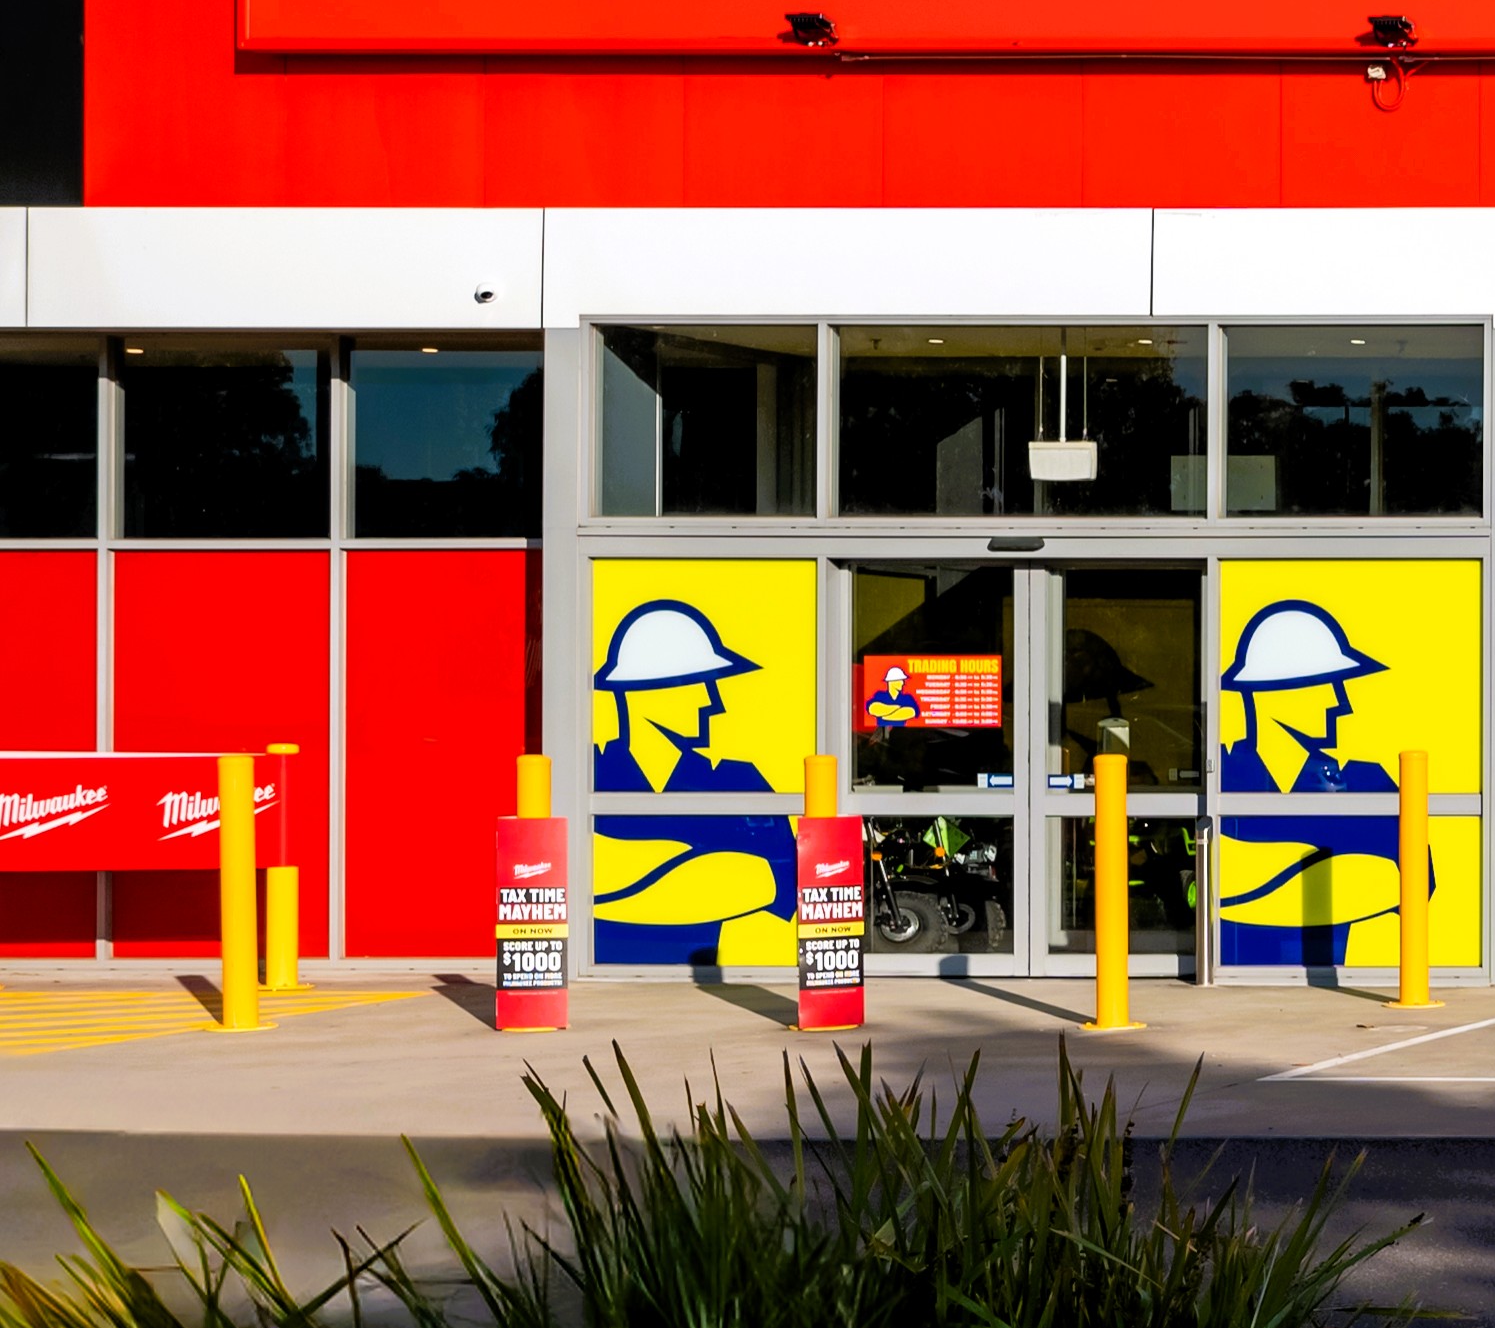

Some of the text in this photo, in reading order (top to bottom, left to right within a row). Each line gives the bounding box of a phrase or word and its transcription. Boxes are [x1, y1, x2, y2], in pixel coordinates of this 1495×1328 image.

[907, 659, 999, 674] TRADING HOURS
[156, 784, 276, 828] Milwee
[500, 888, 565, 903] TAX TIME
[802, 886, 861, 903] TAX TIME
[499, 904, 567, 920] MAYHEM
[801, 902, 863, 920] MAYHEM
[503, 941, 563, 951] SCORE UP TO
[806, 939, 860, 950] SCORE UP TO
